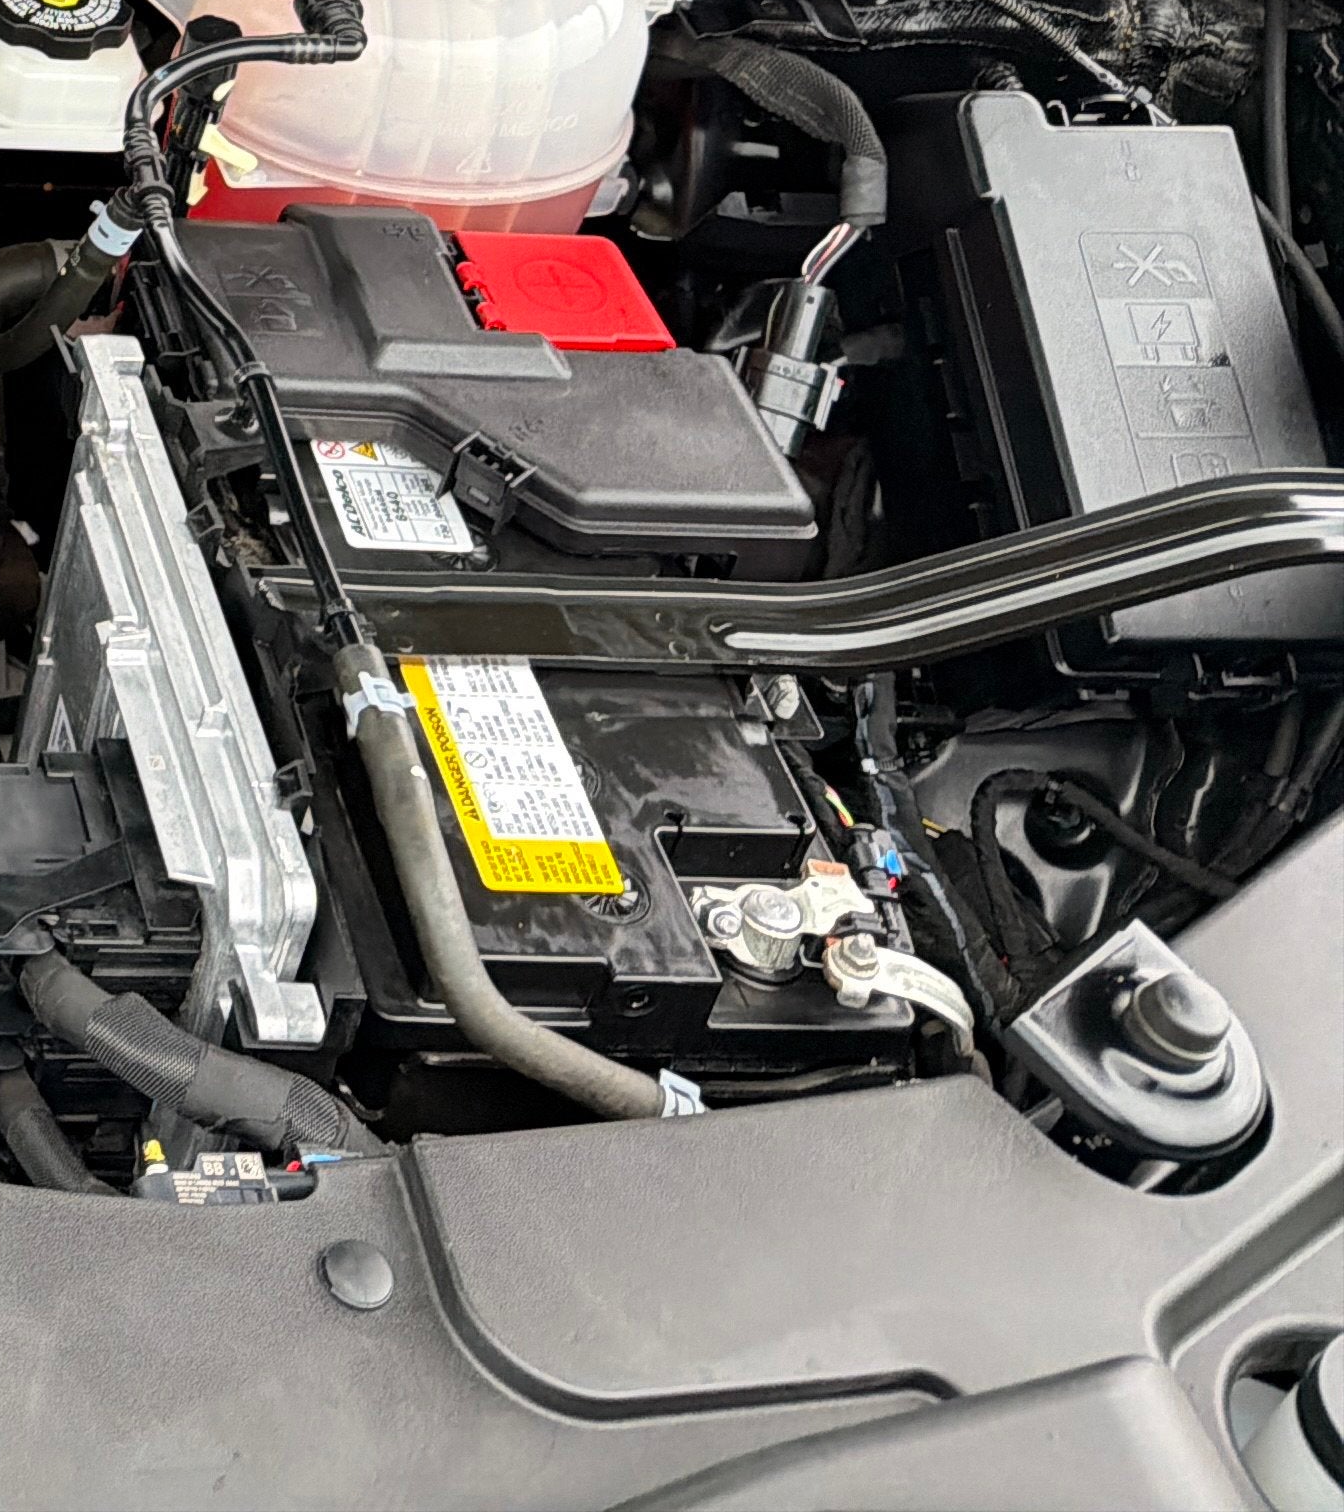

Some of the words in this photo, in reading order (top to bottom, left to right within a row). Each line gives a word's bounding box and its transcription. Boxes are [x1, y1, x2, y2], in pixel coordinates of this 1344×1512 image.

[332, 469, 368, 537] ACDelco
[424, 706, 453, 752] POISON
[445, 756, 475, 807] DANGER
[202, 1161, 225, 1176] BB
